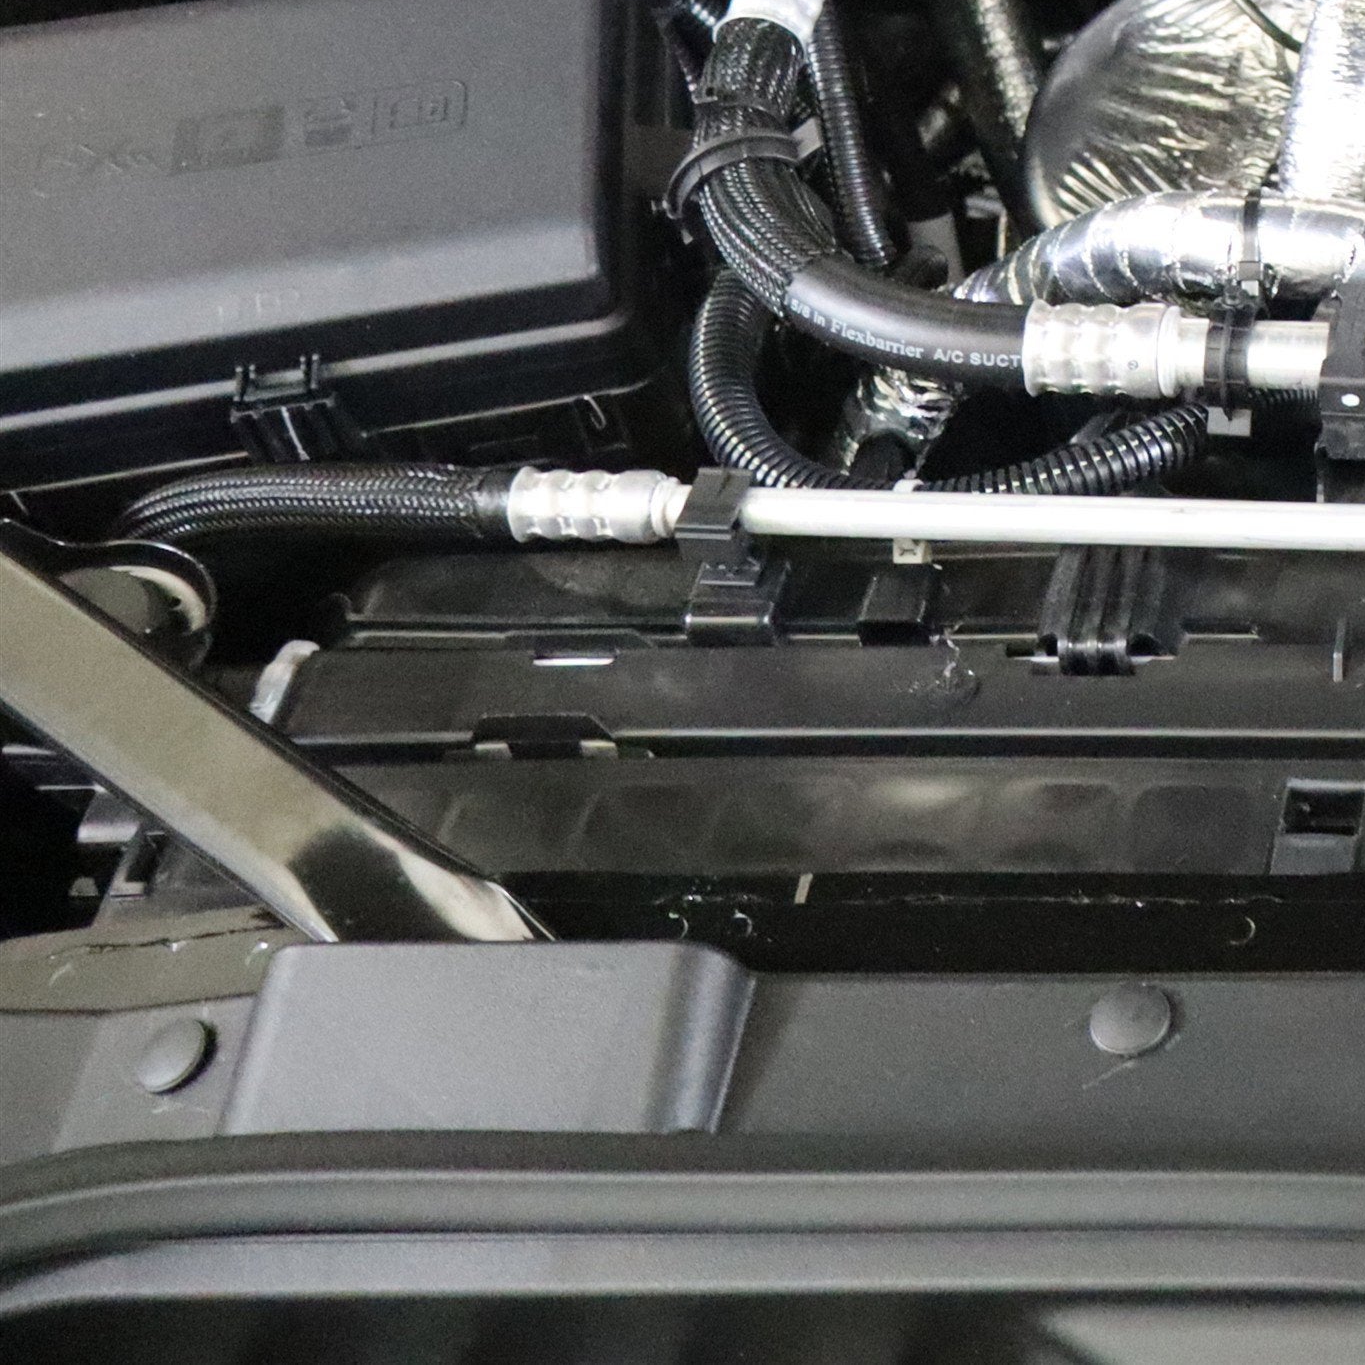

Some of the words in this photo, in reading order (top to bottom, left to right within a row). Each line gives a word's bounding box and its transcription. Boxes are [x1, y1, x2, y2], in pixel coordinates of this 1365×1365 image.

[790, 302, 811, 319] 5/8
[813, 311, 826, 328] in
[830, 319, 923, 359] Flexbarrier
[933, 348, 964, 364] A/C
